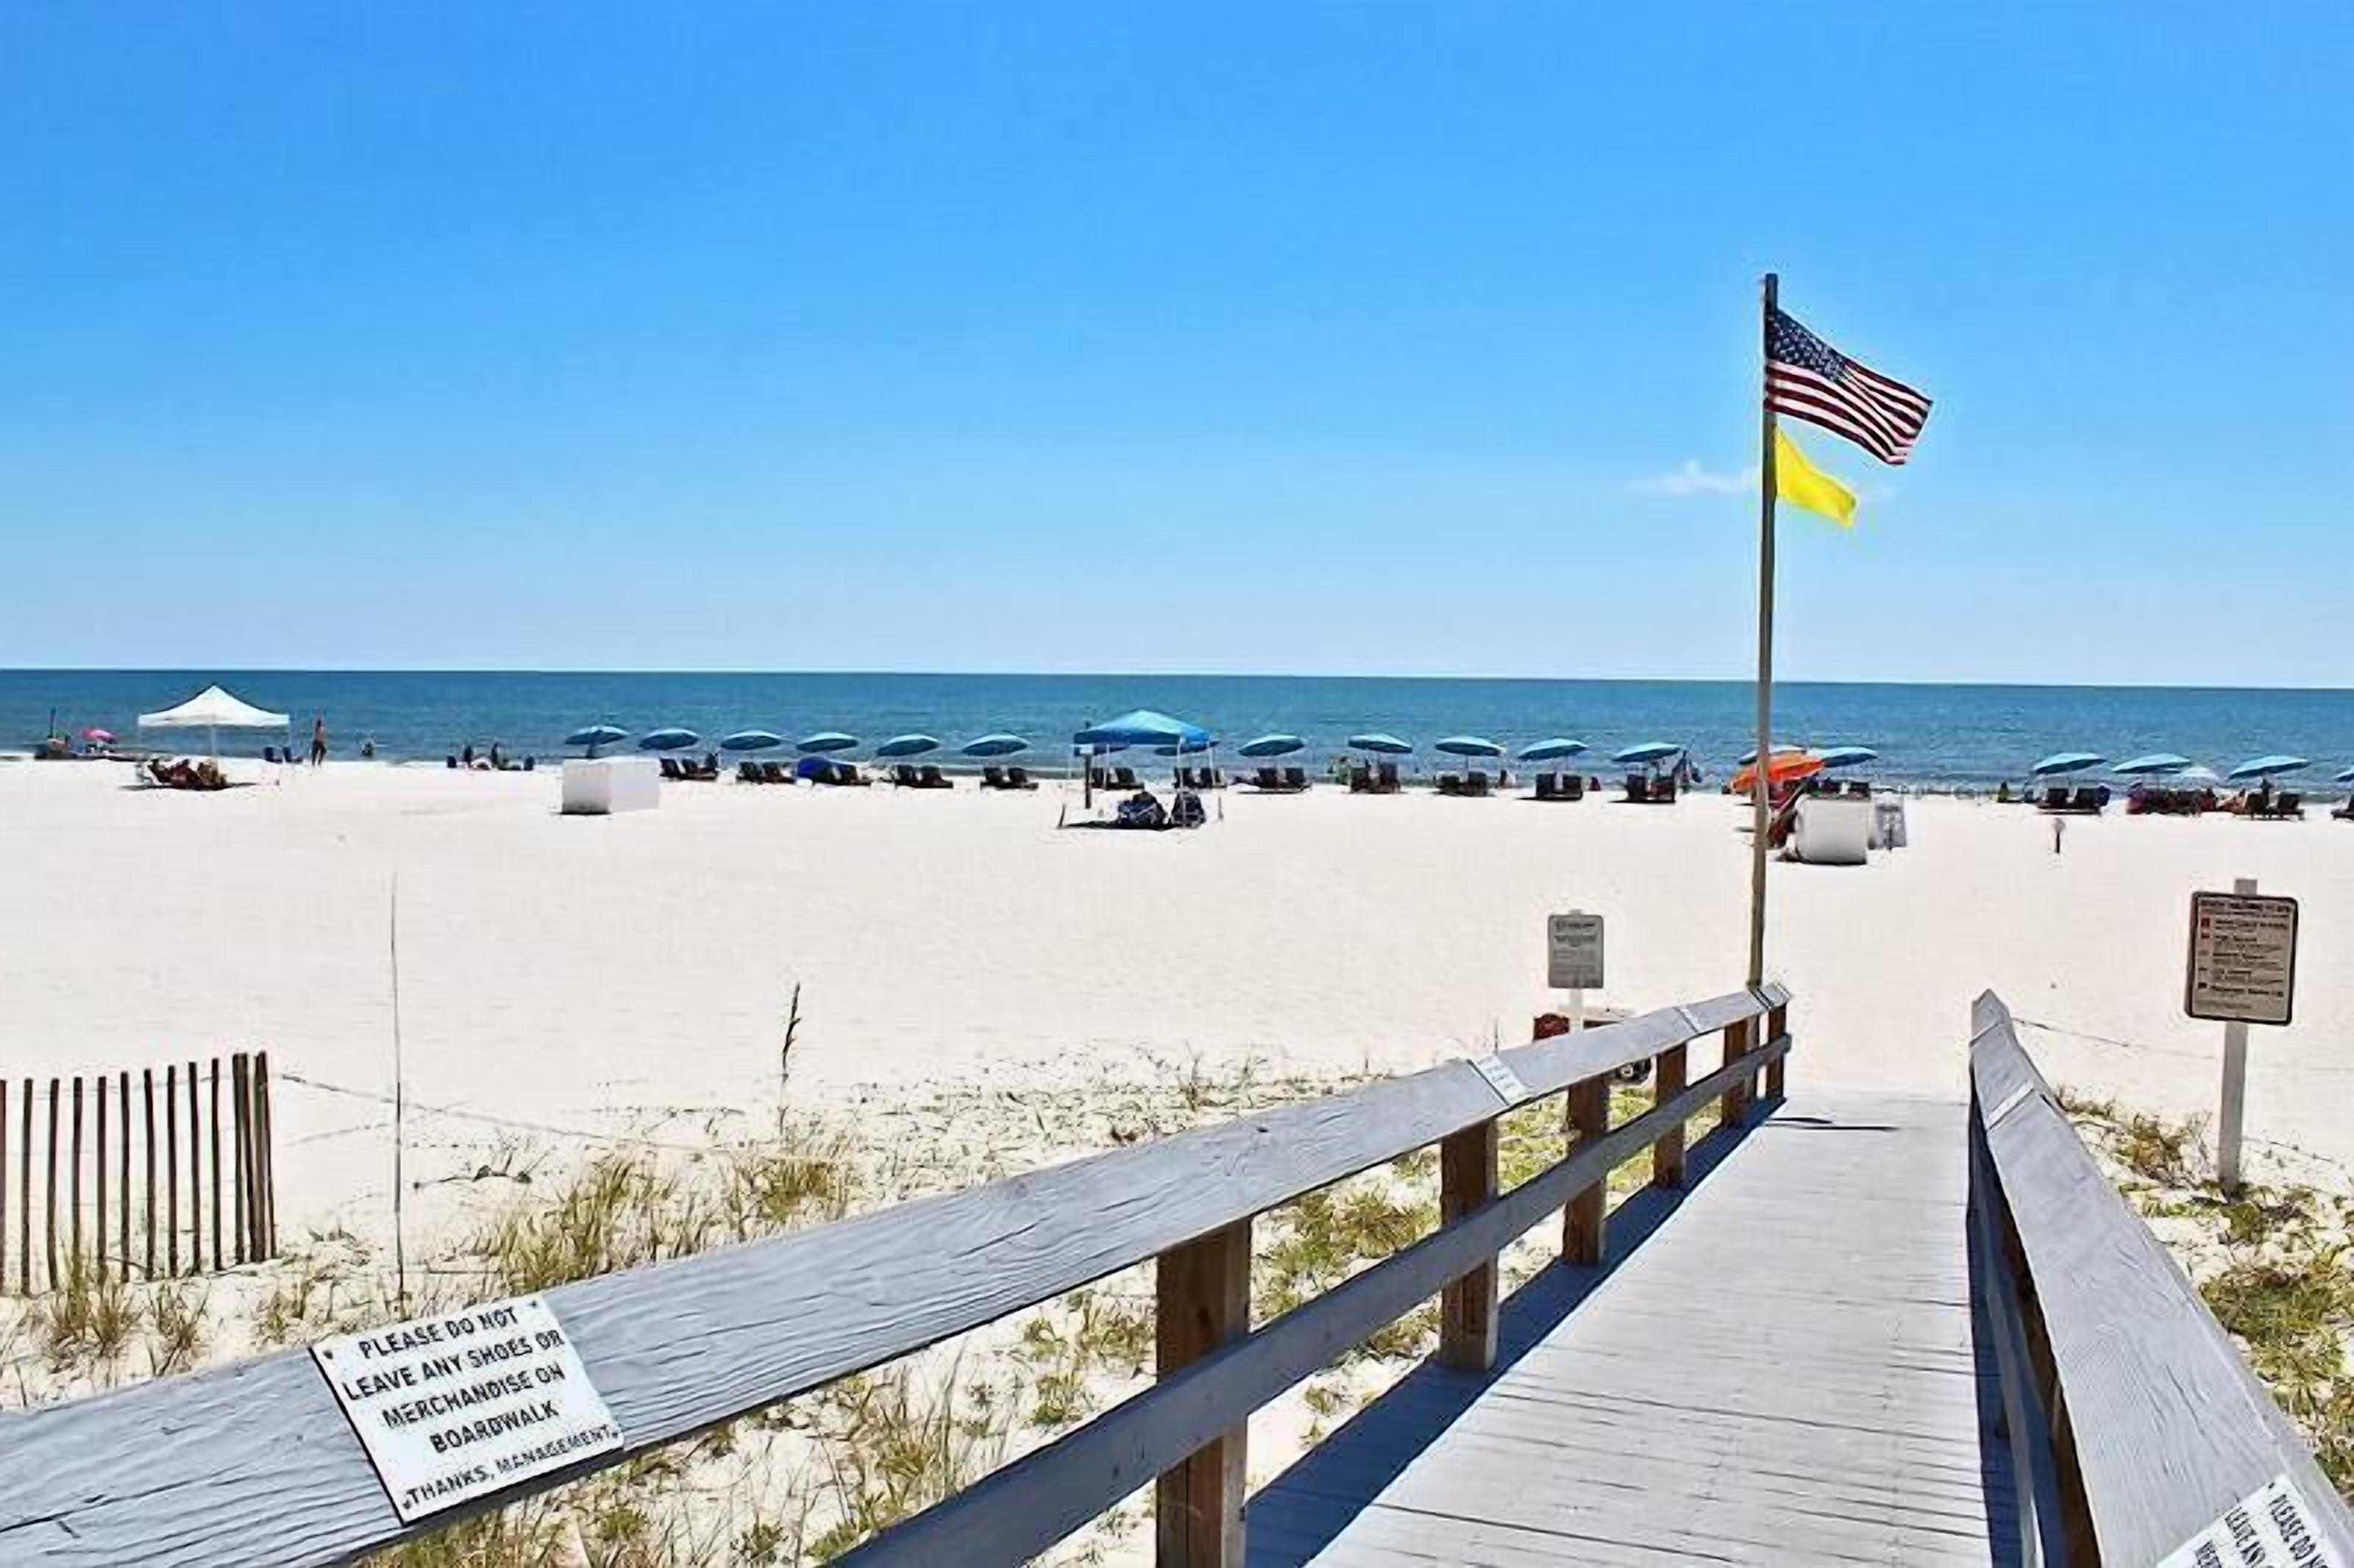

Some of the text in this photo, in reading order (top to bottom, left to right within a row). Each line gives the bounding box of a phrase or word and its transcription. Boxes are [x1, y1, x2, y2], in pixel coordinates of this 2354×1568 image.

[358, 1306, 517, 1359] PLEASE DO NOT
[342, 1330, 565, 1400] LEAVE ANY SHOES OR
[381, 1363, 566, 1428] MERCHANDISE ON
[430, 1400, 560, 1453] BOARDWALK
[406, 1465, 494, 1505] THANKS,
